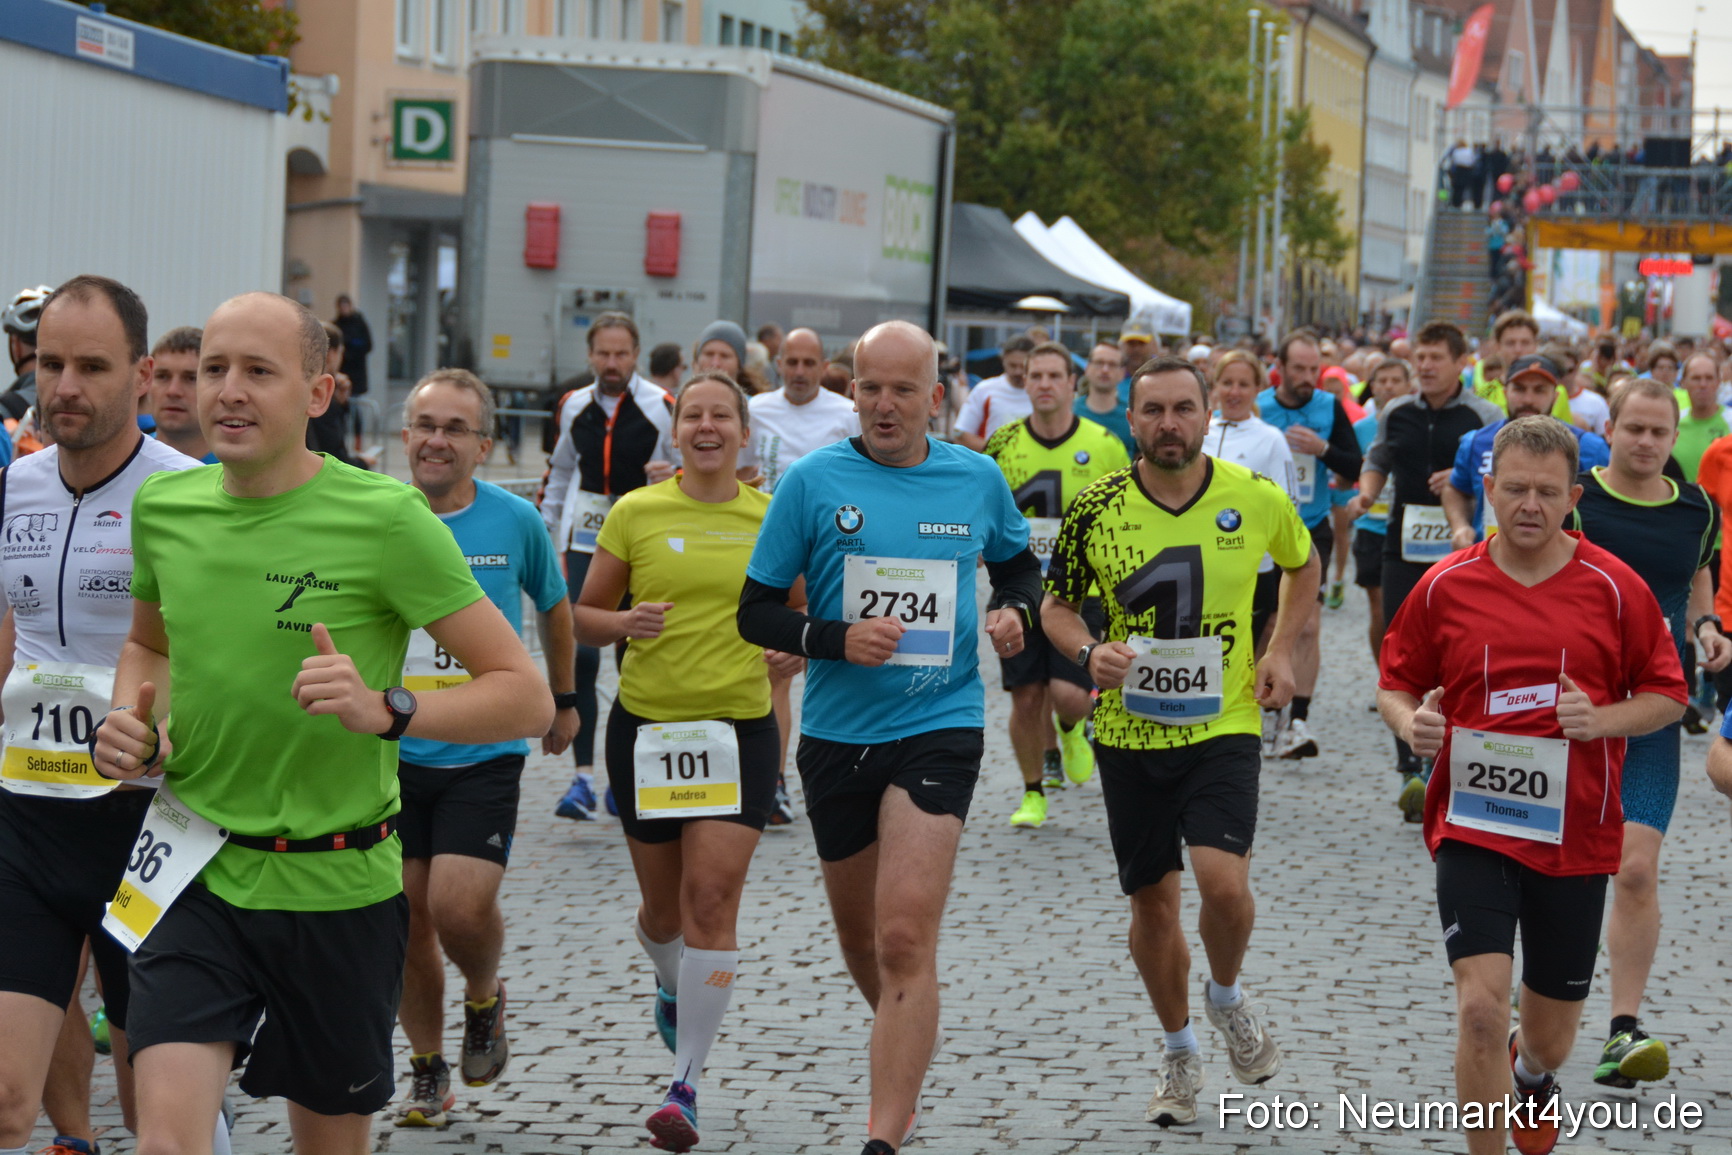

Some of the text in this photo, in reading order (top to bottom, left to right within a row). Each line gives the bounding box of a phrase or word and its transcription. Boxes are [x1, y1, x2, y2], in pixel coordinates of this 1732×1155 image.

[401, 106, 446, 154] D
[918, 522, 971, 537] BOCK
[1412, 523, 1453, 540] 2722
[836, 538, 865, 546] PARTL
[888, 568, 924, 577] BOCK
[266, 573, 339, 591] LAUFMASCHE
[860, 590, 938, 623] 2734
[277, 620, 313, 632] DAVID
[434, 643, 464, 670] 5
[1161, 648, 1194, 656] BOCK
[43, 674, 84, 687] BOCK
[1137, 666, 1208, 693] 2664
[1160, 702, 1185, 712] Erich
[1507, 692, 1538, 706] DEHN
[31, 702, 93, 744] 110
[672, 730, 707, 739] BOCK
[1494, 742, 1534, 756] BOCK
[27, 756, 88, 774] Sebastian
[660, 750, 709, 780] 101
[1467, 762, 1548, 799] 2520
[670, 790, 707, 801] Andrea
[1484, 801, 1529, 820] Thomas
